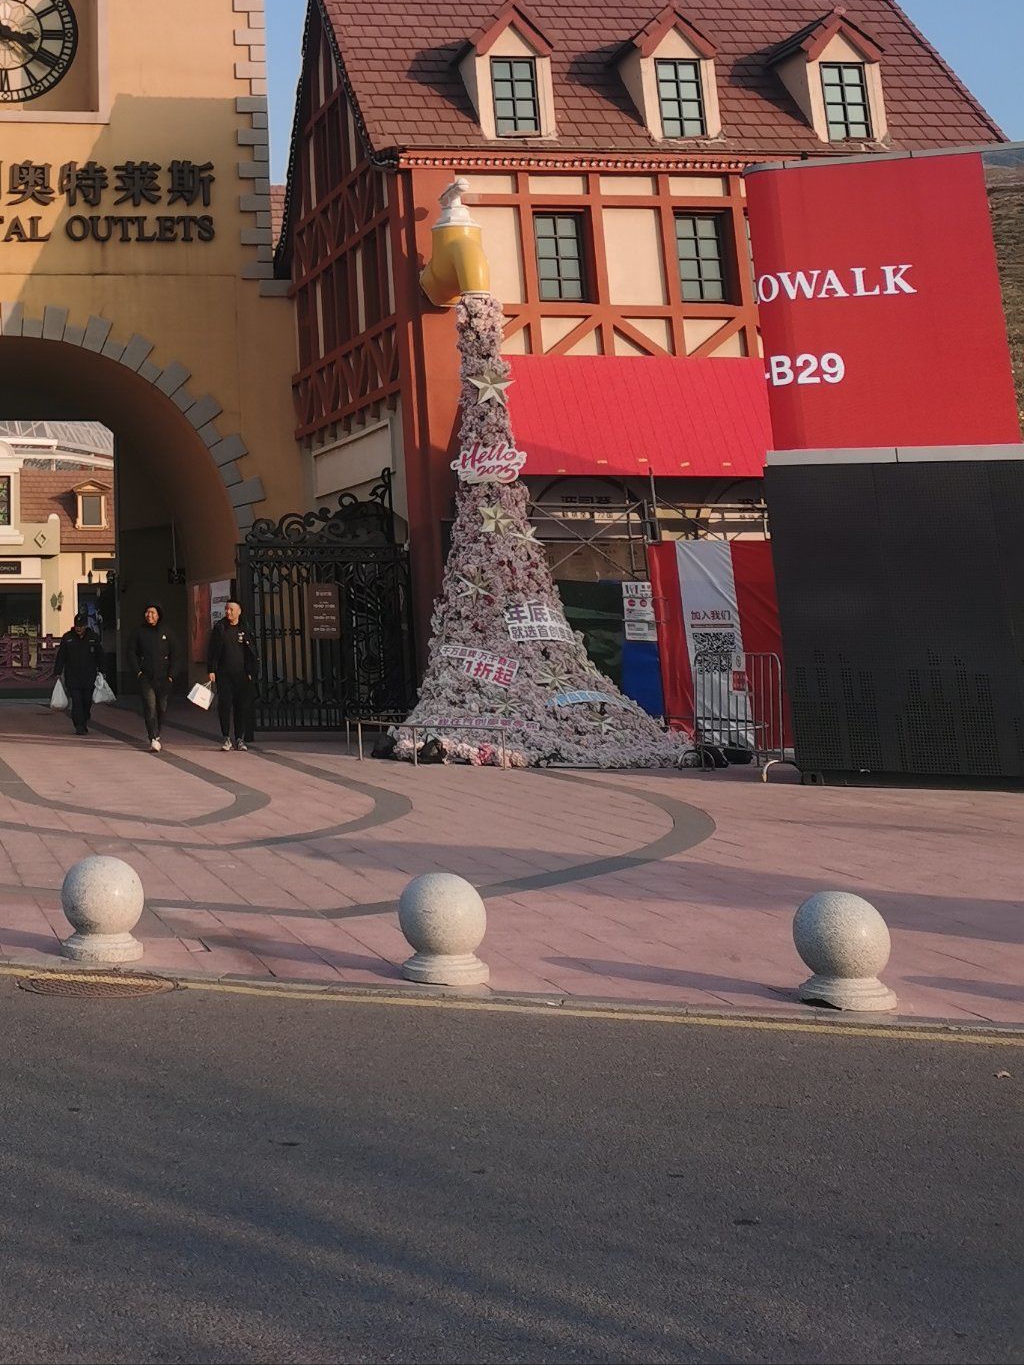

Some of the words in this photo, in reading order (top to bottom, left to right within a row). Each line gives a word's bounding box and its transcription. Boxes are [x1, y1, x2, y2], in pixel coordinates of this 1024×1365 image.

[66, 214, 216, 242] OUTLETS
[757, 264, 918, 305] OWALK
[454, 441, 517, 469] Hello
[476, 462, 521, 481] 2025
[691, 610, 731, 620] 加入我们
[464, 659, 515, 686] 1折起
